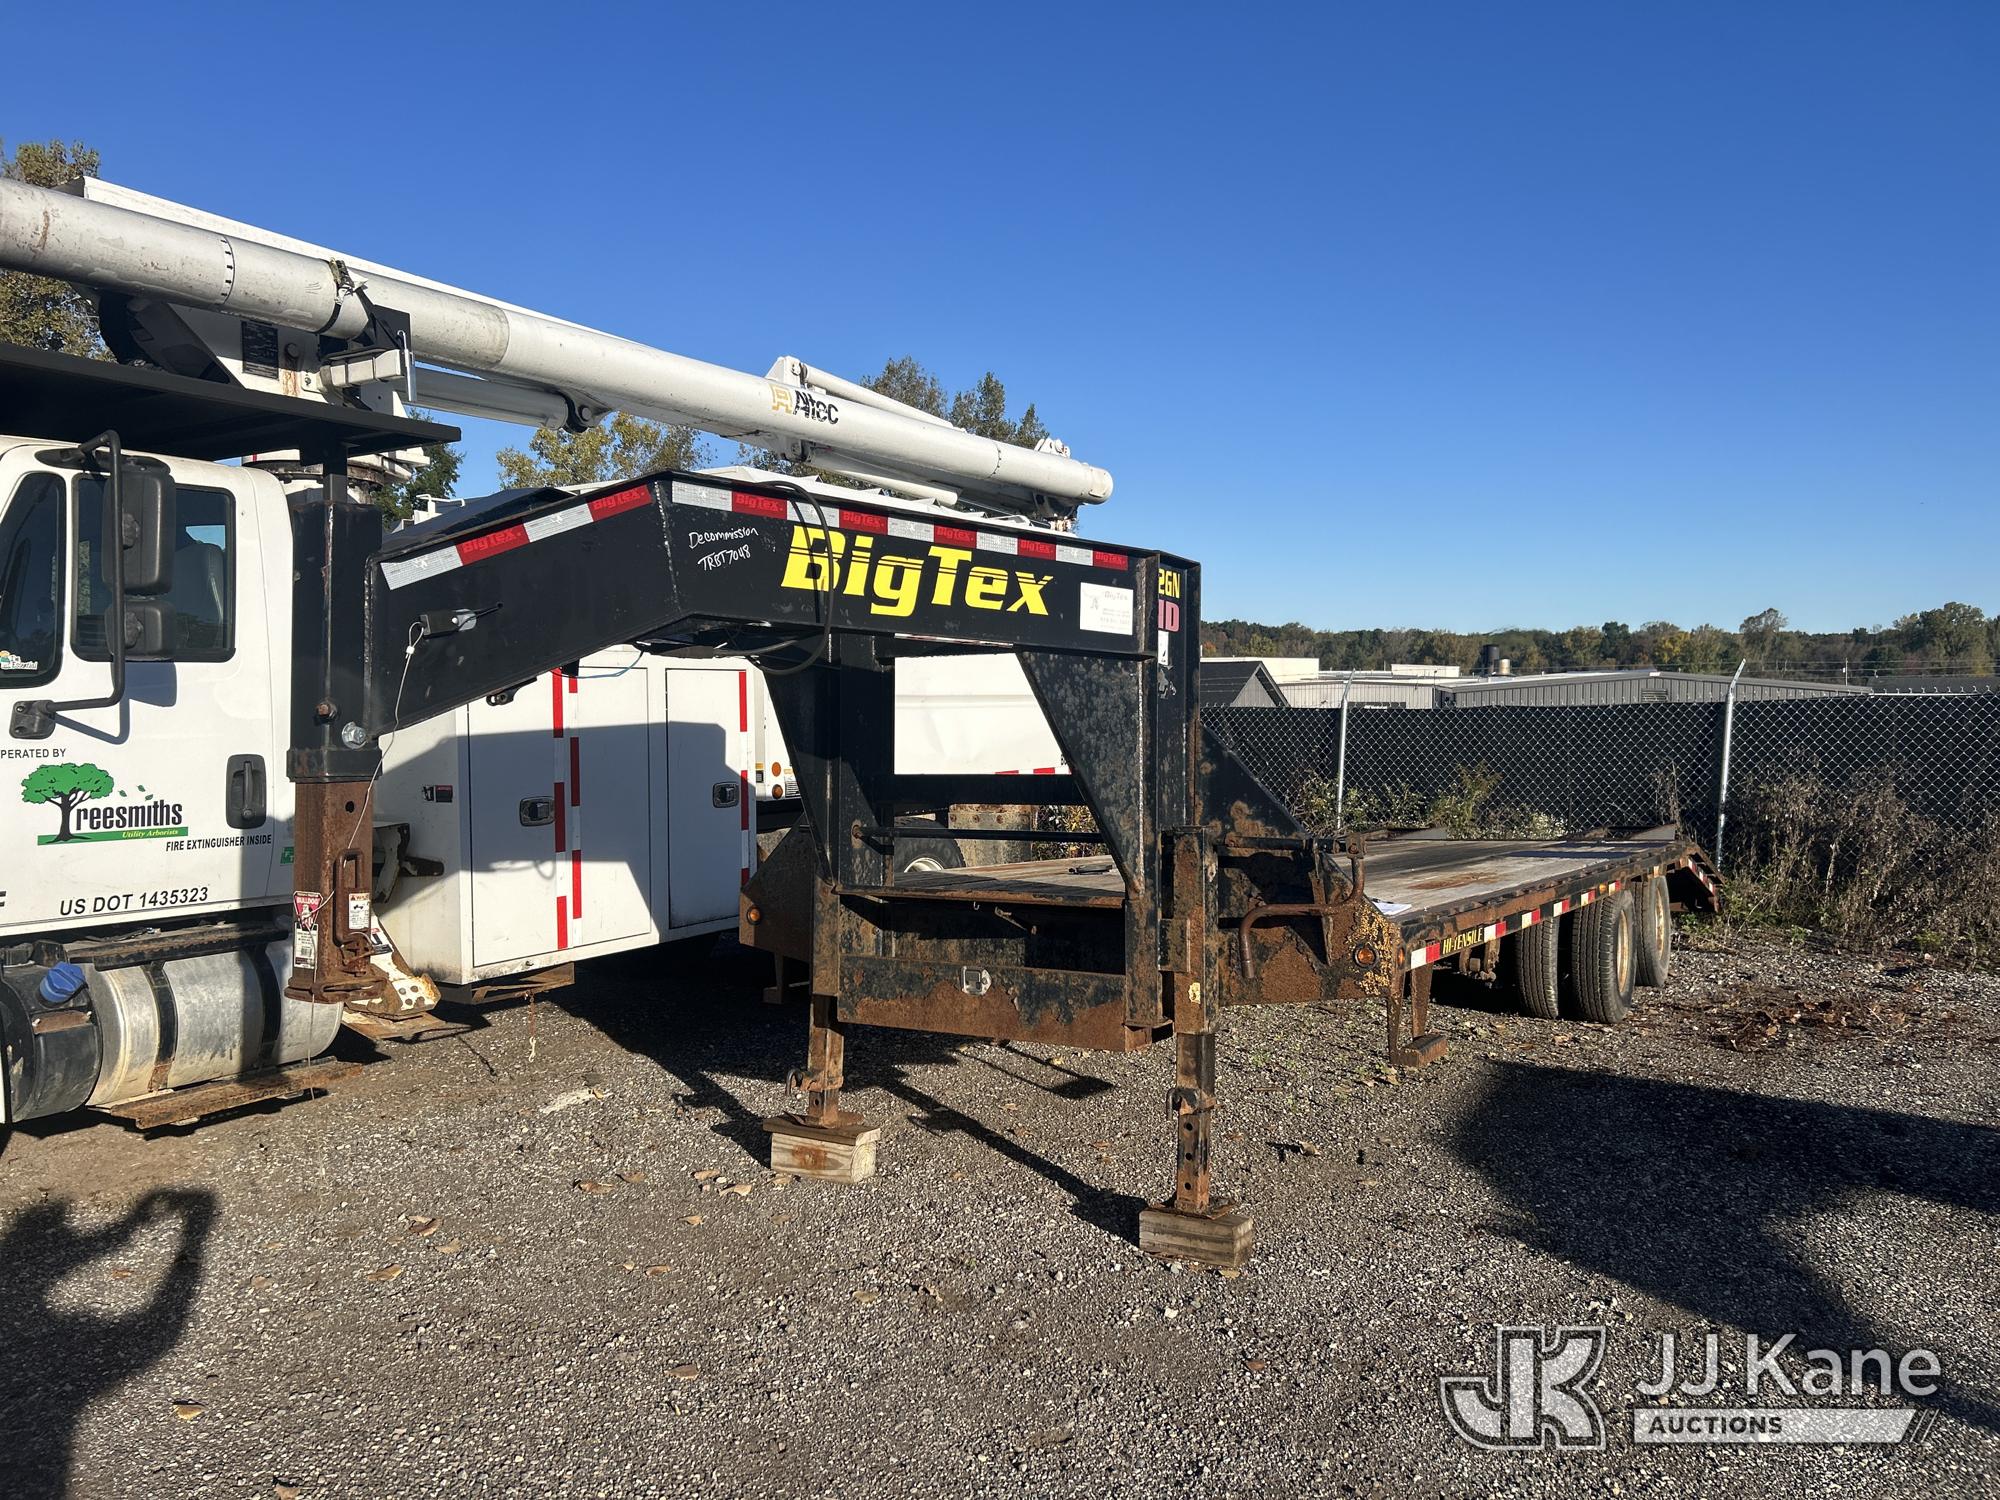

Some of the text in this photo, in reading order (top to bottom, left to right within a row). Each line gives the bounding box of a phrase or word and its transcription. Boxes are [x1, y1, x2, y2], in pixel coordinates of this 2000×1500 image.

[688, 526, 760, 549] Decommission
[52, 748, 67, 758] BY
[122, 829, 179, 839] Utility Arborists
[166, 834, 272, 851] FIRE EXTINGUISHER INSIDE
[60, 886, 209, 916] US DOT 1435323
